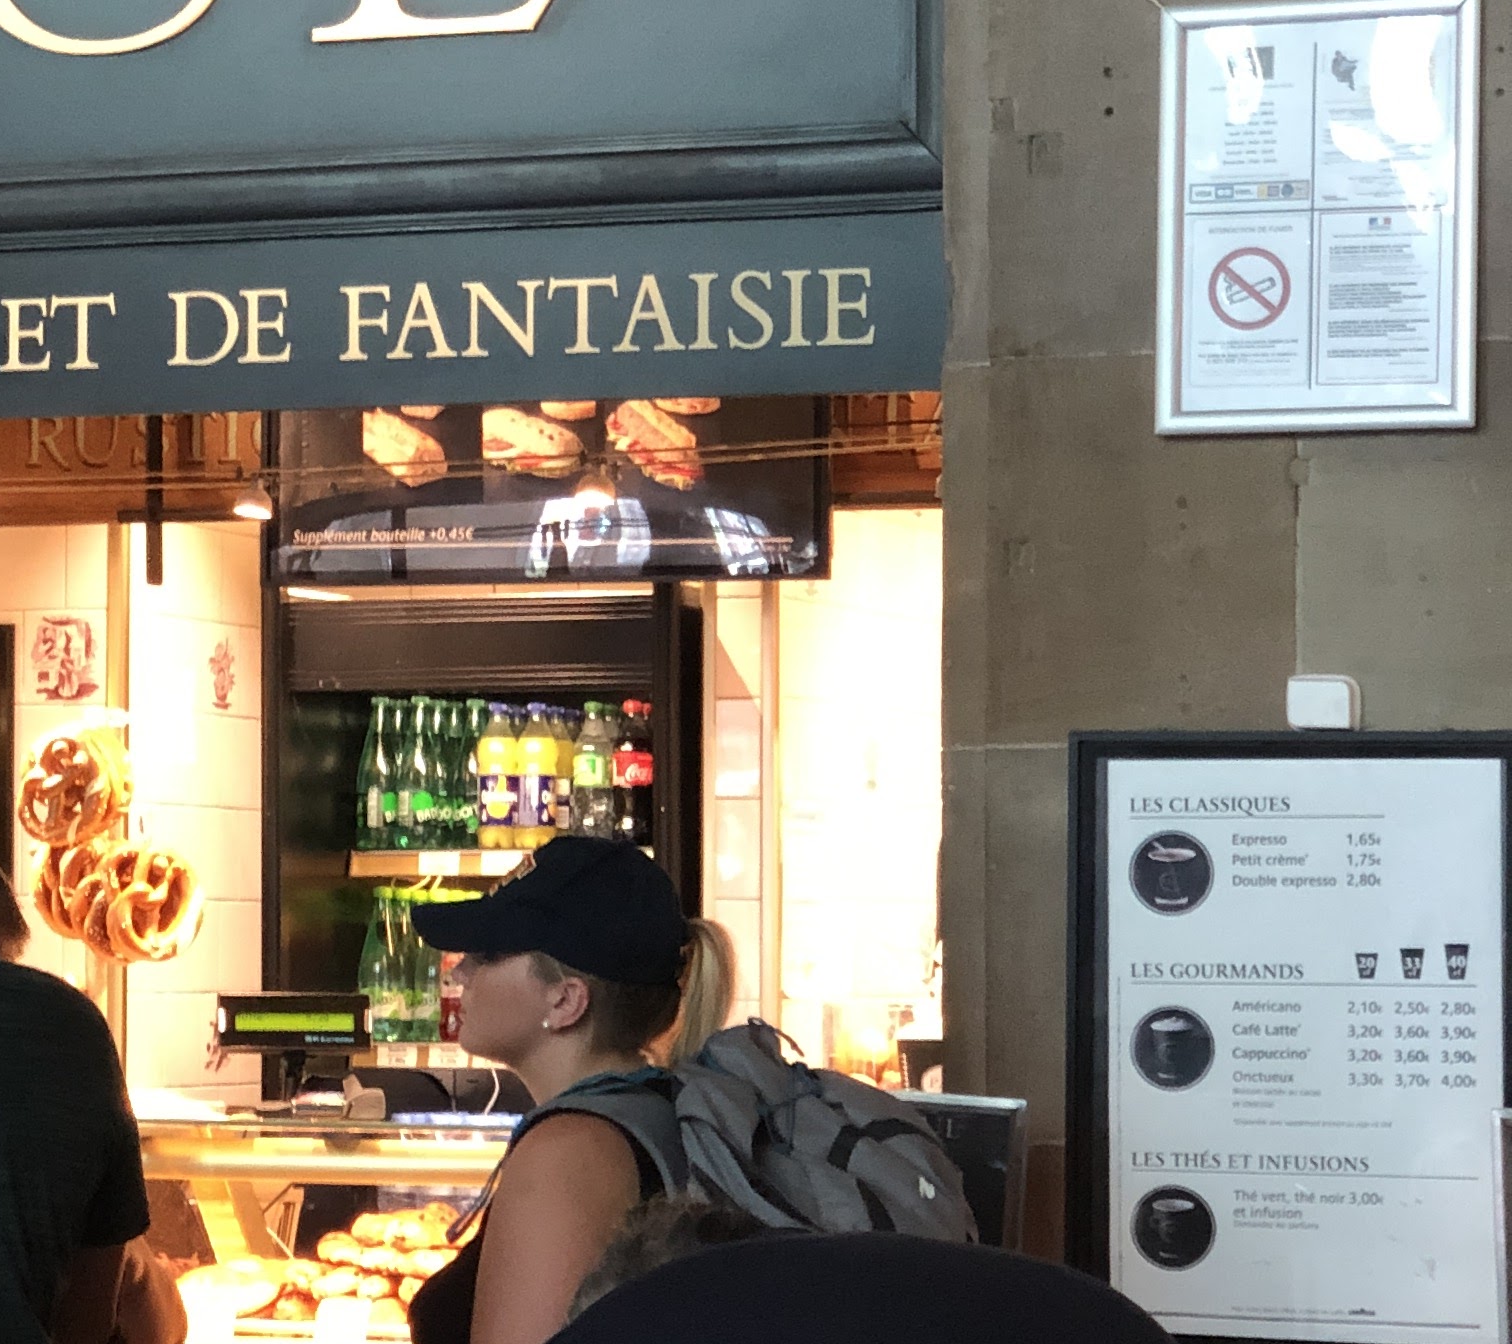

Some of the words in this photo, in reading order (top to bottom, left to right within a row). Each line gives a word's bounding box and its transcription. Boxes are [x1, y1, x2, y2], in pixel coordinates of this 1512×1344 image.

[0, 292, 116, 371] ET
[168, 288, 291, 366] DE
[340, 268, 875, 361] FANTAISIE
[370, 527, 426, 544] bouteille
[1129, 796, 1164, 814] LES
[1169, 796, 1291, 817] CLASSIQUES
[1231, 833, 1288, 847] Expresso
[1346, 833, 1382, 847] 1,65€
[1231, 853, 1263, 866] Petit
[1346, 853, 1382, 868] 1,75€
[1231, 874, 1278, 888] Double
[1281, 876, 1337, 890] expresso
[1130, 962, 1164, 979] LES
[1169, 962, 1305, 981] GOURMANDS
[1231, 999, 1302, 1014] Américano
[1231, 1023, 1261, 1036] Café
[1231, 1070, 1295, 1085] Onctueux
[1131, 1151, 1165, 1168] LES
[1169, 1150, 1221, 1169] THÉS
[1227, 1154, 1252, 1170] ET
[1258, 1154, 1370, 1173] INFUSIONS
[1233, 1189, 1258, 1203] Thé
[1261, 1191, 1289, 1205] vert,
[1294, 1190, 1316, 1204] thé
[1319, 1191, 1345, 1205] noir
[1232, 1207, 1246, 1219] et
[1249, 1206, 1303, 1220] infusion
